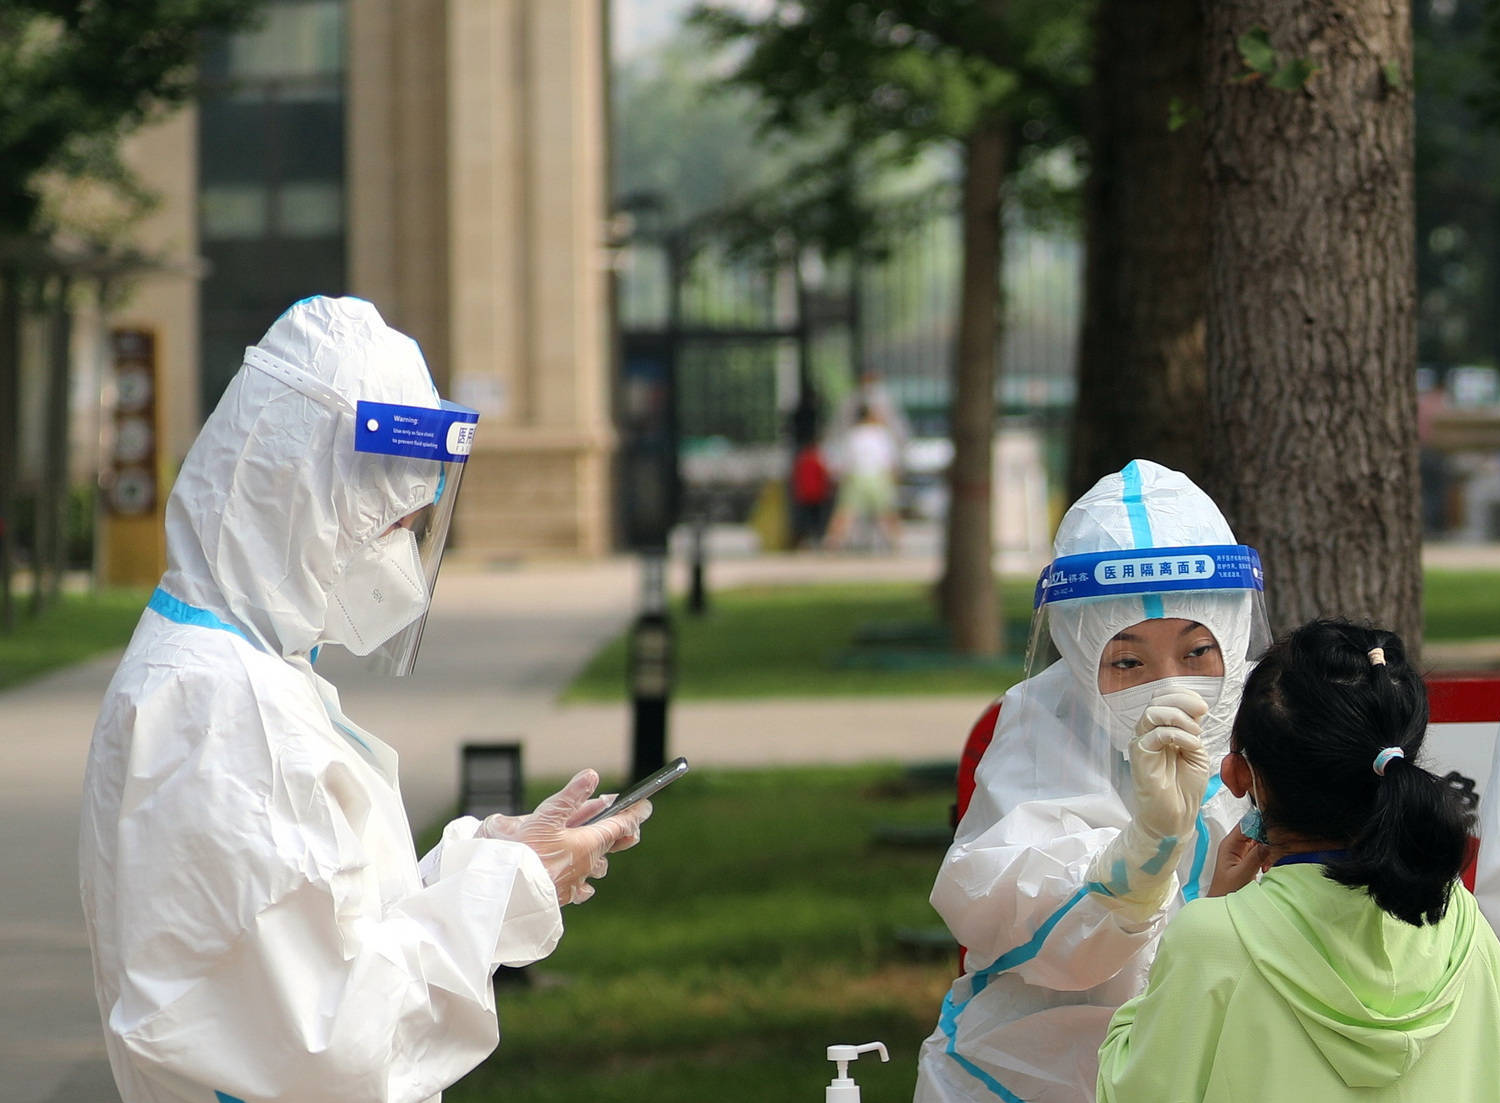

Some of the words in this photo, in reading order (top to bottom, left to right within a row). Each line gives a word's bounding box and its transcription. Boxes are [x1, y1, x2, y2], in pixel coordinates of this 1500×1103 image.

[1104, 560, 1207, 580] 医用隔离面罩
